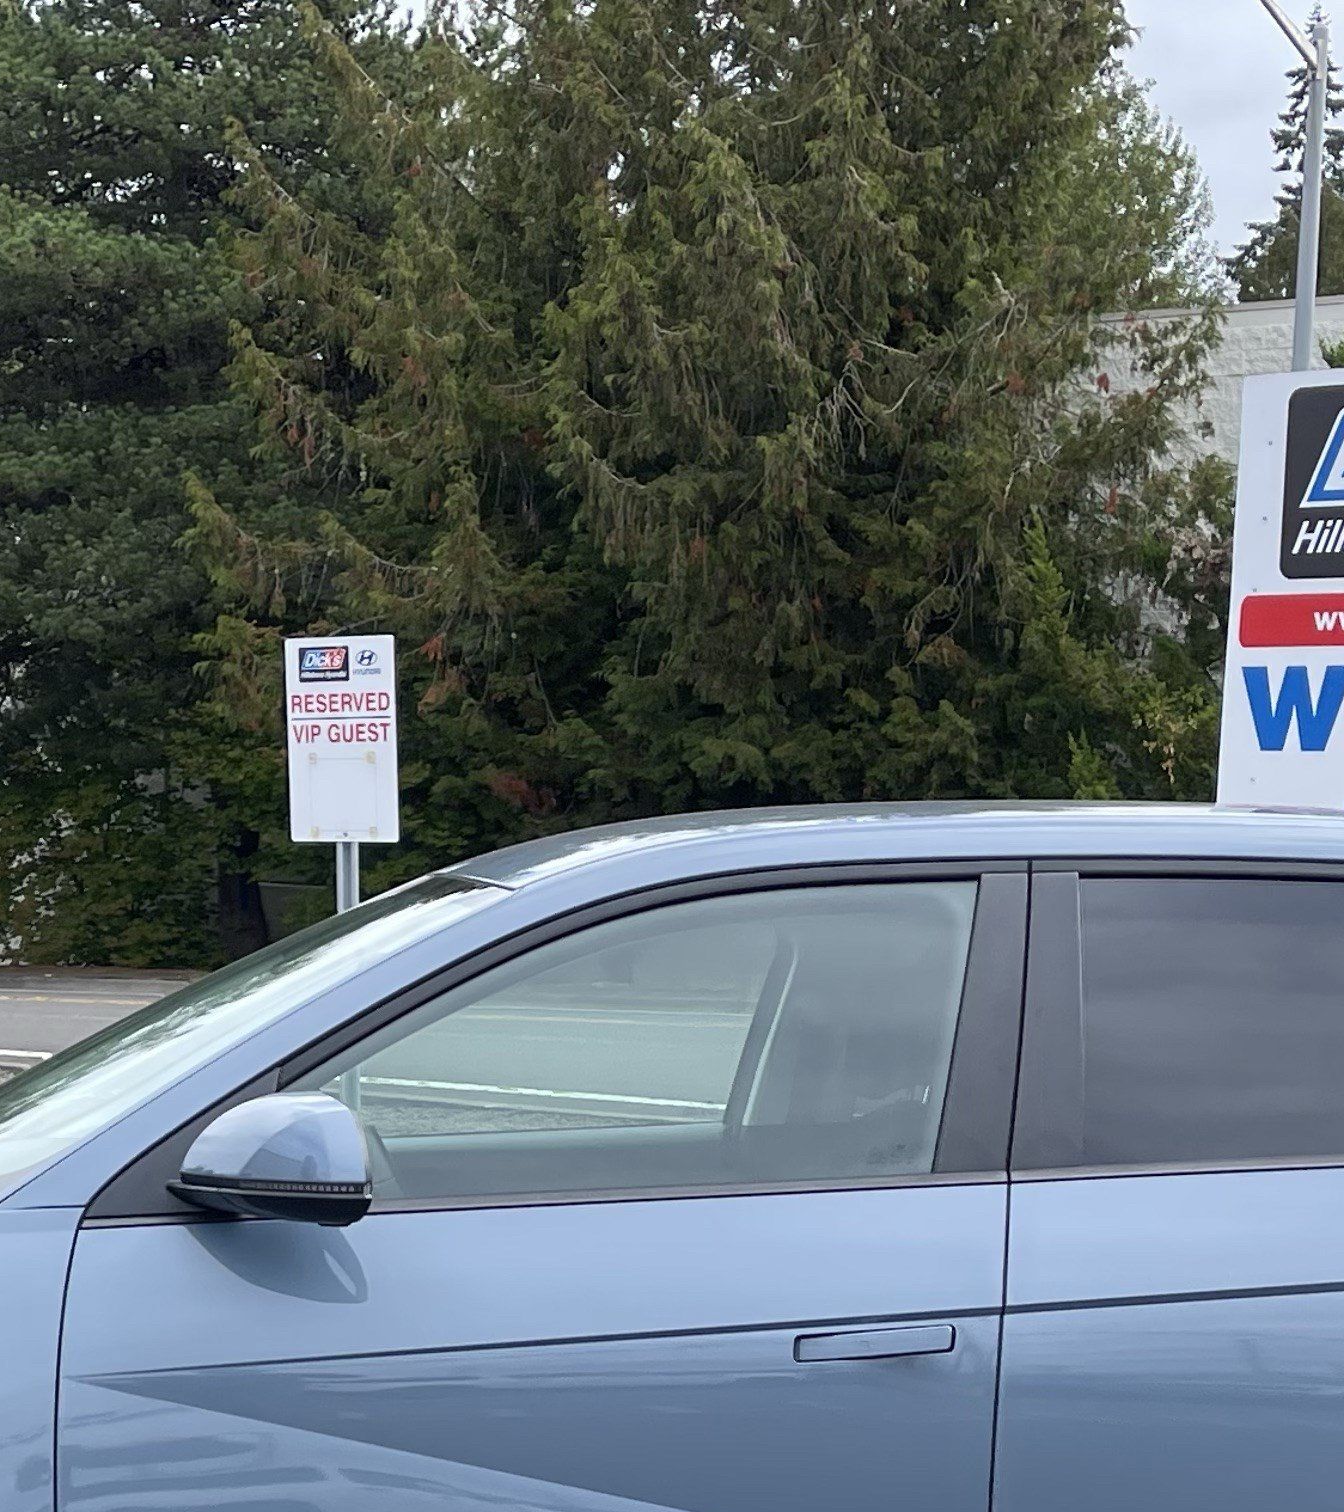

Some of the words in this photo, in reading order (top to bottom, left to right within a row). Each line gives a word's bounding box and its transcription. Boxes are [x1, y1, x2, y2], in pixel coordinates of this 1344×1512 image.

[291, 692, 390, 713] RESERVED
[293, 724, 321, 744] VIP
[328, 722, 391, 743] GUEST
